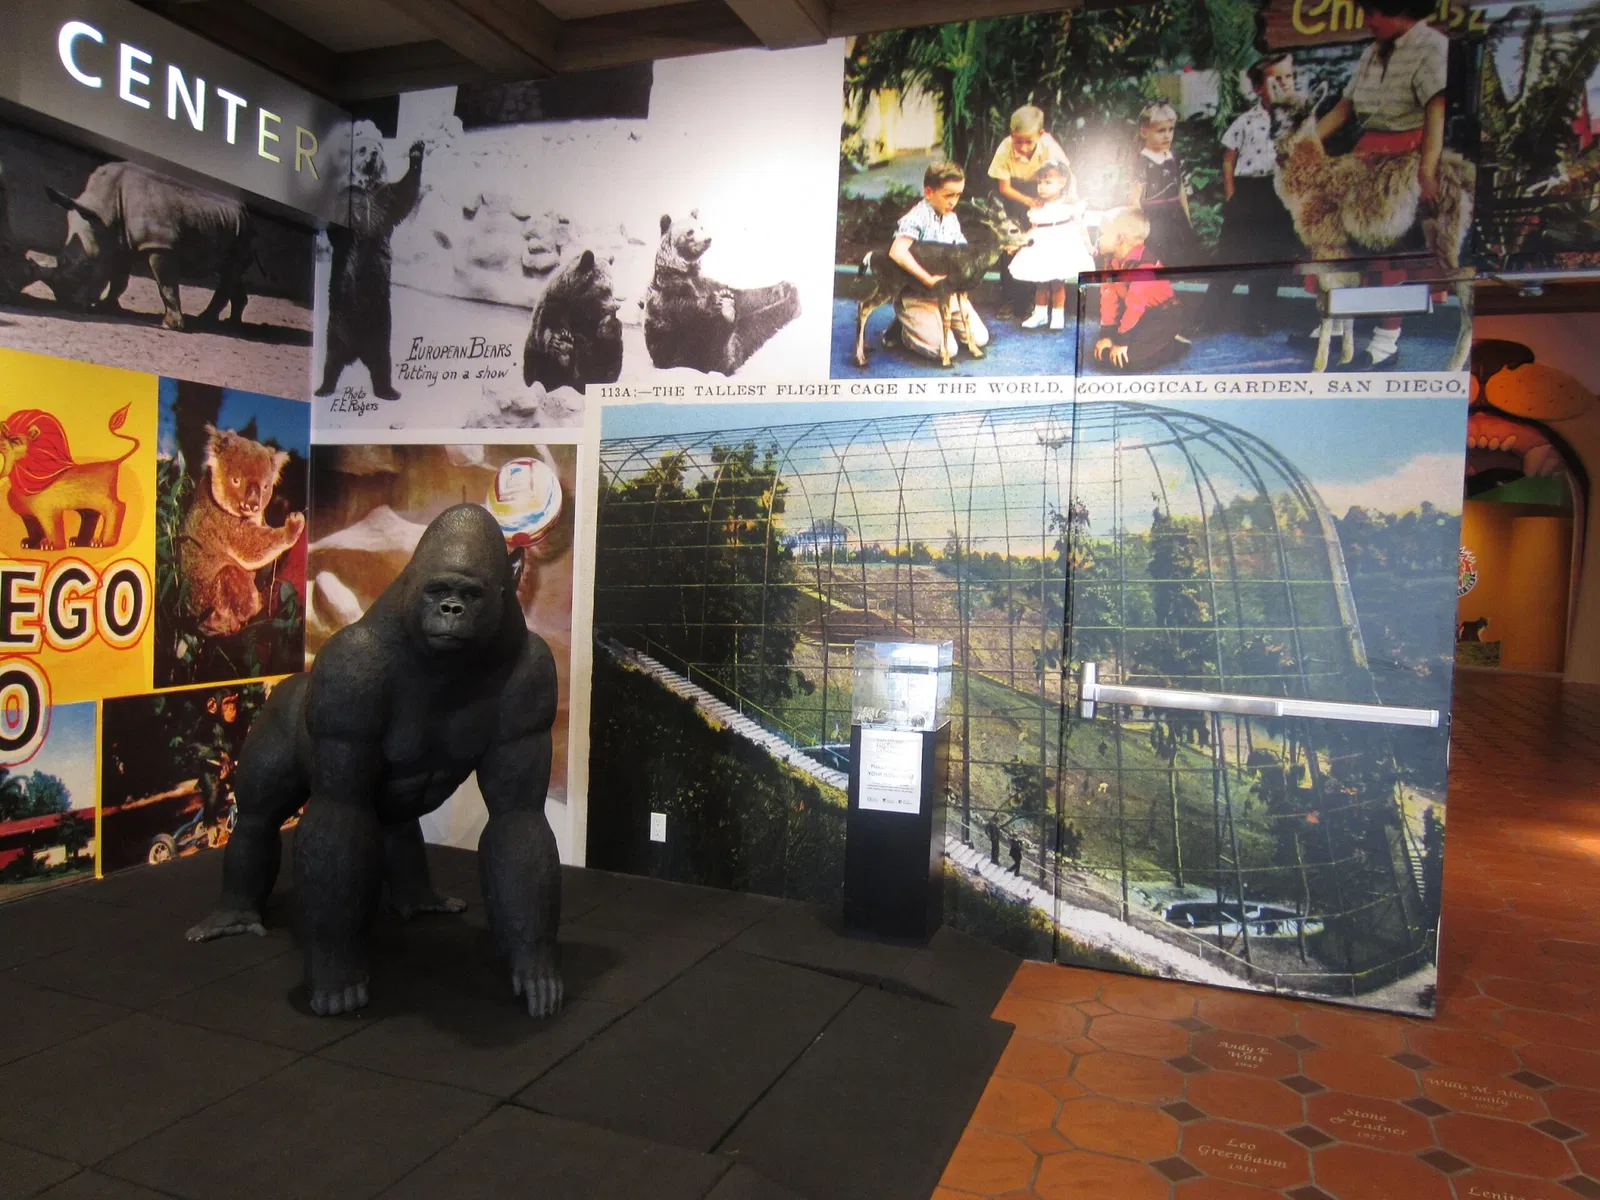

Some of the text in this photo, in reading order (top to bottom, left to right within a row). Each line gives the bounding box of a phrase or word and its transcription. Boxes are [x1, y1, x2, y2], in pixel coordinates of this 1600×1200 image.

[57, 20, 321, 181] CENTER
[442, 371, 457, 380] on
[462, 370, 470, 380] a
[694, 384, 766, 396] TALLEST
[776, 383, 841, 396] FLIGHT
[850, 383, 898, 395] CAGE
[908, 383, 926, 394] IN
[938, 382, 976, 394] THE
[1214, 380, 1313, 395] GARDEN,
[1327, 379, 1371, 393] SAN
[1385, 379, 1467, 395] DIEGO,
[1343, 1108, 1387, 1121] Stone
[1350, 1119, 1408, 1136] Ladner
[1226, 1138, 1256, 1150] Leo
[1198, 1144, 1288, 1169] Greenbaum
